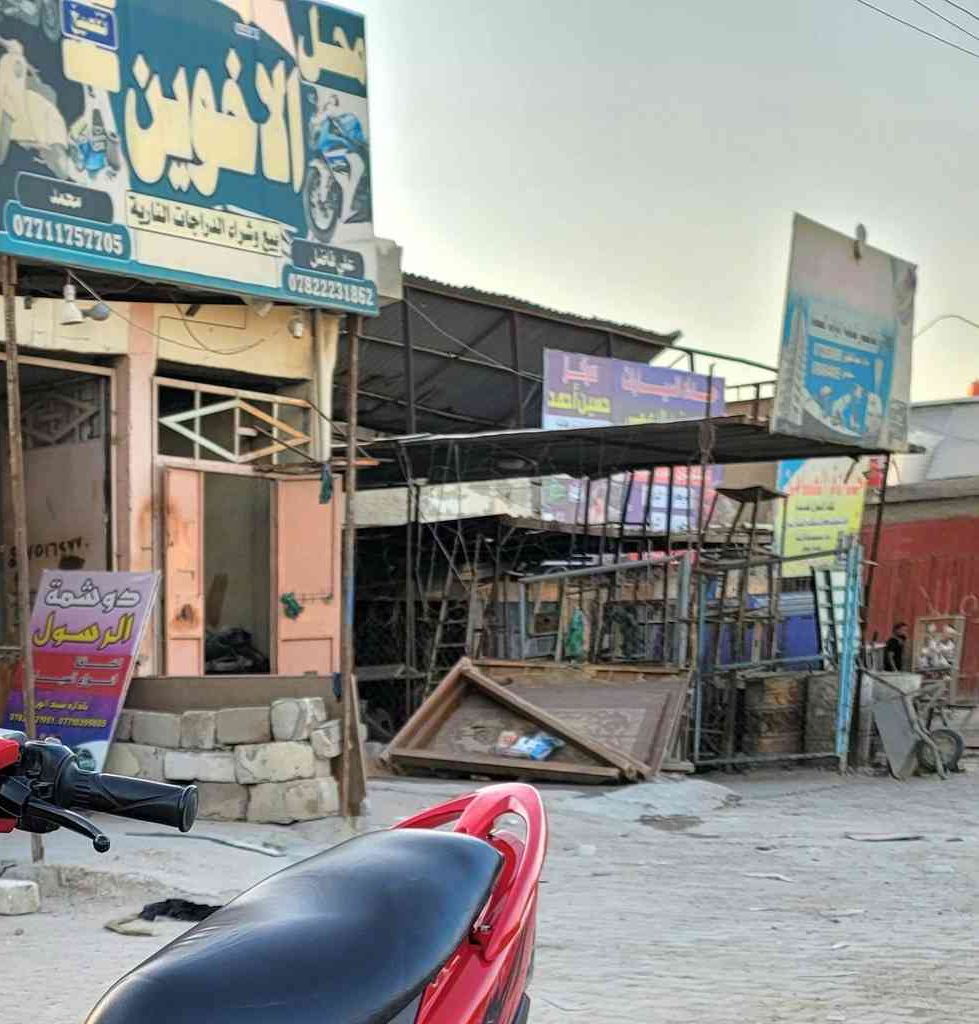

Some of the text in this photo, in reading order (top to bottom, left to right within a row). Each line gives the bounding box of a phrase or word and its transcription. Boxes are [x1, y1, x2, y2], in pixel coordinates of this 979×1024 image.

[297, 3, 366, 85] محل
[125, 48, 305, 197] الاخوين
[128, 195, 171, 226] النارية
[173, 205, 225, 238] الدراجات
[12, 213, 124, 256] 07711757705
[44, 577, 142, 614] دوشمة
[31, 609, 136, 652] الرسول
